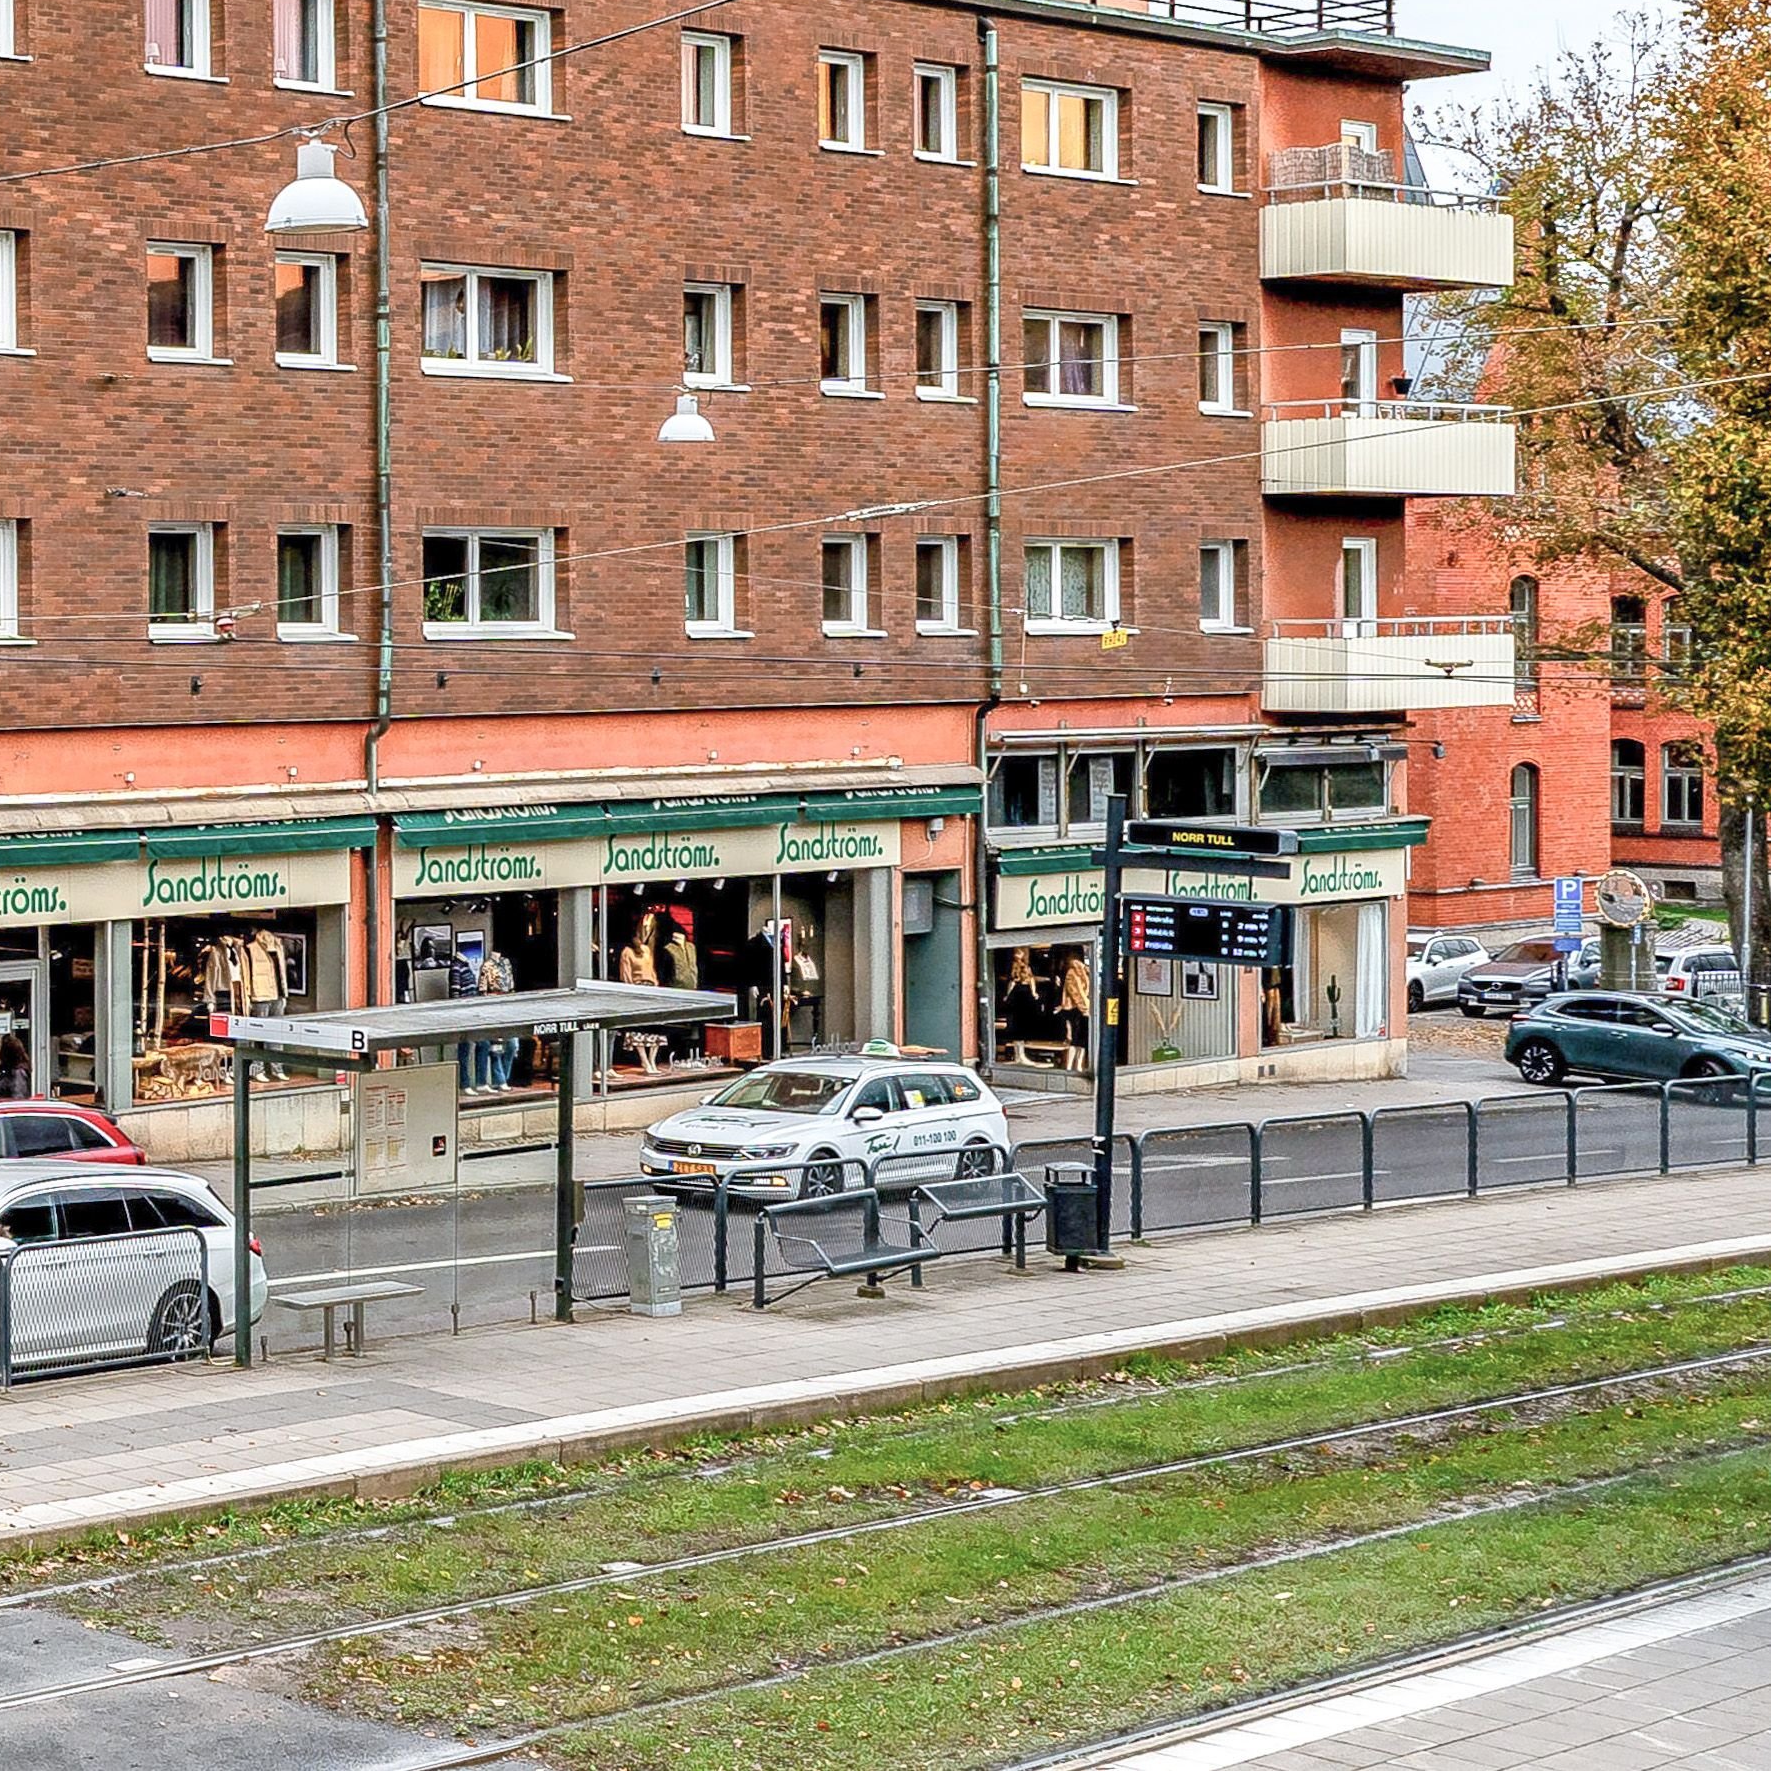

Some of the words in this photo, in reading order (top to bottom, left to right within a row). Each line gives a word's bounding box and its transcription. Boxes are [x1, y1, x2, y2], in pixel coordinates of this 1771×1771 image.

[1172, 831, 1205, 844] NORR
[1206, 834, 1235, 846] TULL
[1561, 880, 1578, 900] P
[533, 1022, 558, 1035] NORR
[559, 1021, 579, 1032] TULL
[351, 1030, 365, 1050] B
[913, 1132, 942, 1147] 011-100
[943, 1130, 957, 1142] 100
